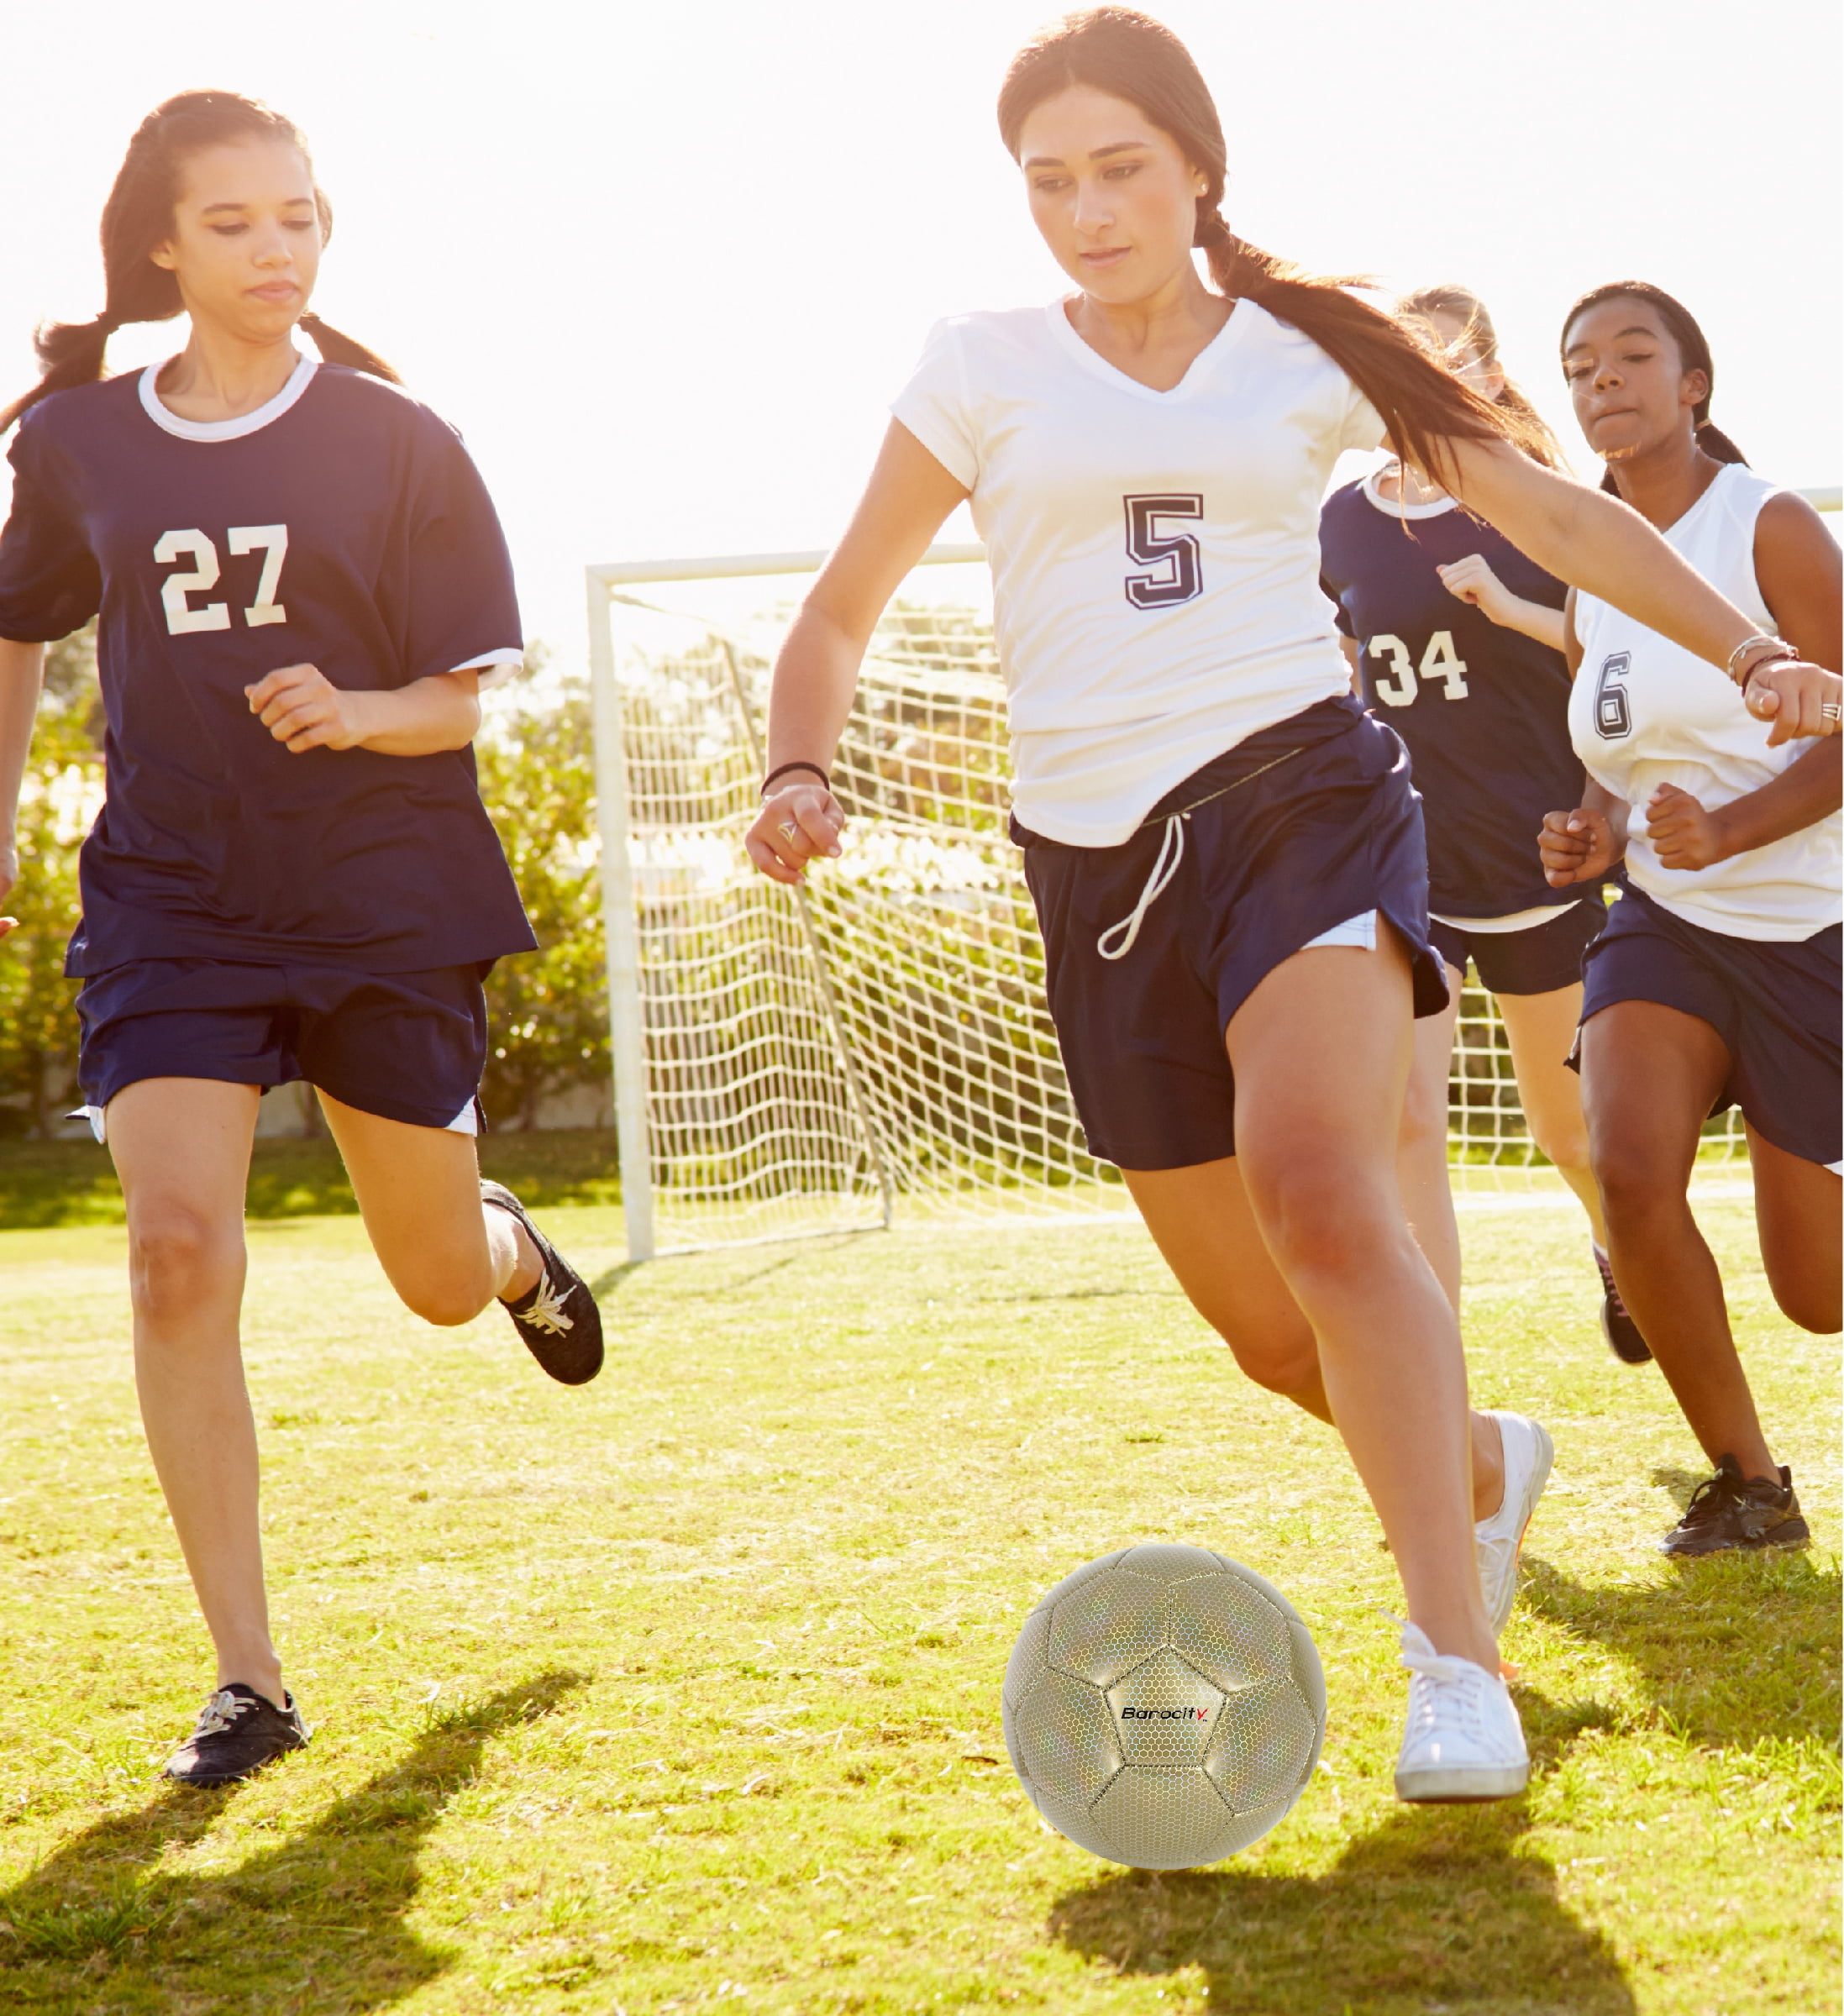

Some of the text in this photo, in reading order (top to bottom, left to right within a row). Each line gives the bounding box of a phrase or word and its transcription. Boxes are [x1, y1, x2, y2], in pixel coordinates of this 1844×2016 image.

[154, 524, 288, 635] 27
[1122, 493, 1203, 610] 5
[1368, 631, 1468, 706] 34
[1594, 650, 1631, 739] 6
[1122, 1707, 1208, 1720] Barocity
